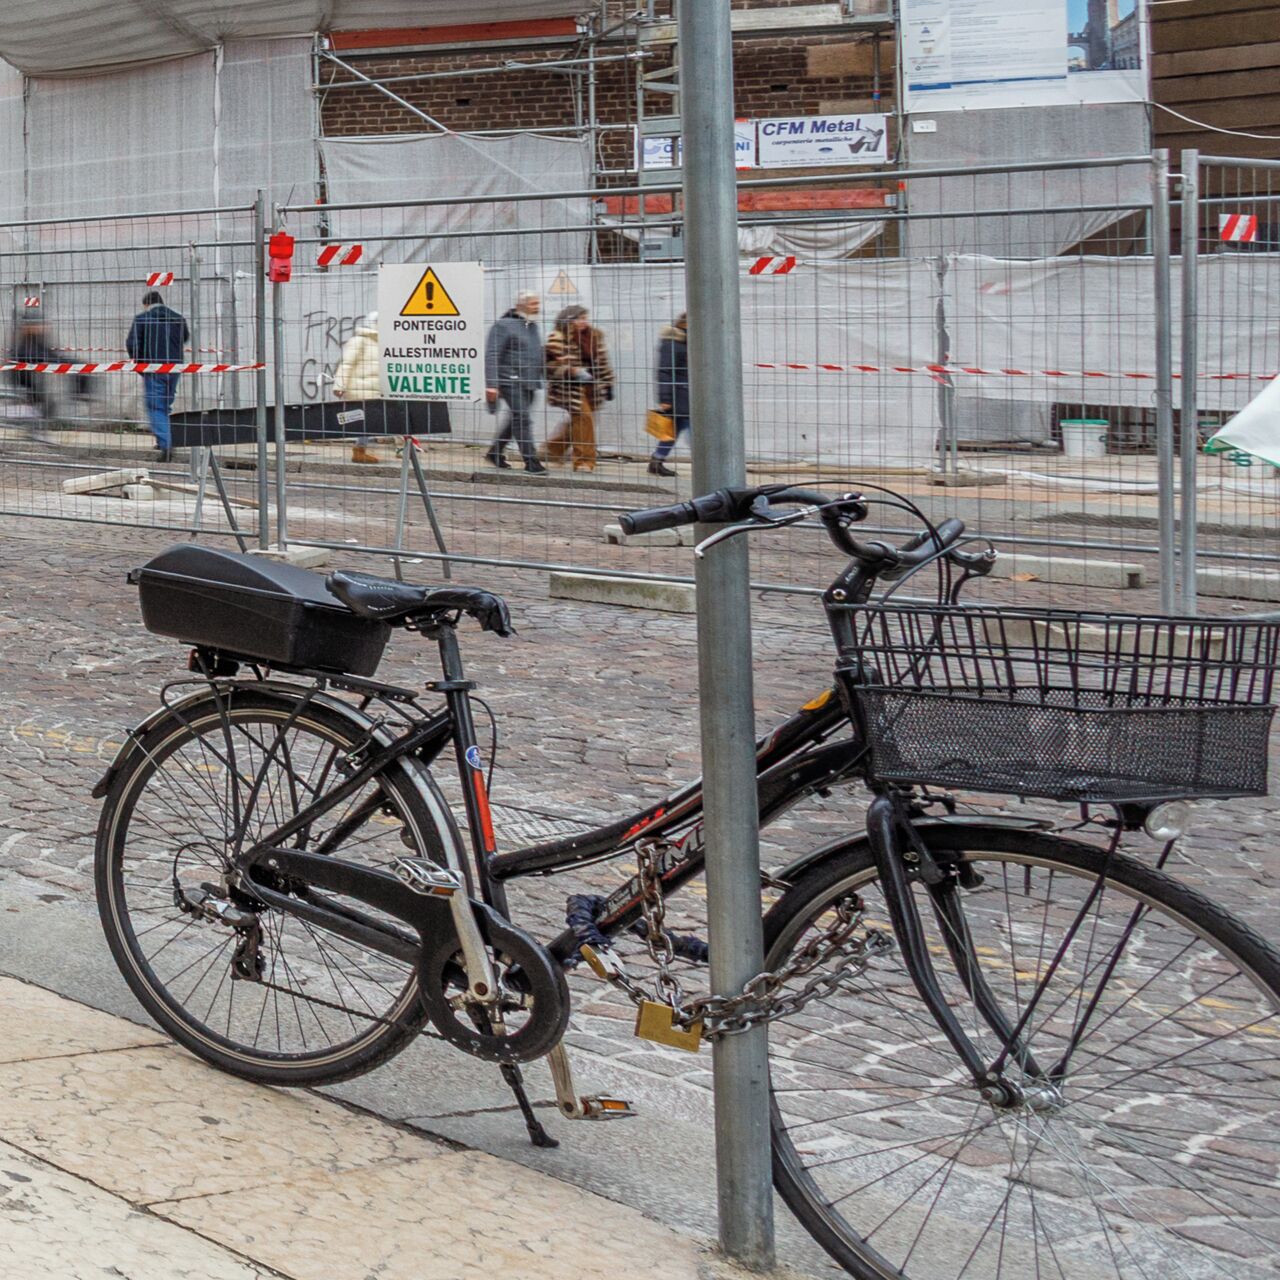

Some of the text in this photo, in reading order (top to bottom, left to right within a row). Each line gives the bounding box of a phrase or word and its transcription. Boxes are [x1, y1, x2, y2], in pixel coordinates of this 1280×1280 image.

[762, 118, 861, 136] CFM Metal
[393, 320, 467, 331] PONTEGGIO
[423, 334, 436, 345] IN
[383, 347, 477, 359] ALLESTIMENTO
[387, 362, 470, 374] EDILNOLEGGI
[388, 375, 471, 394] VALENTE
